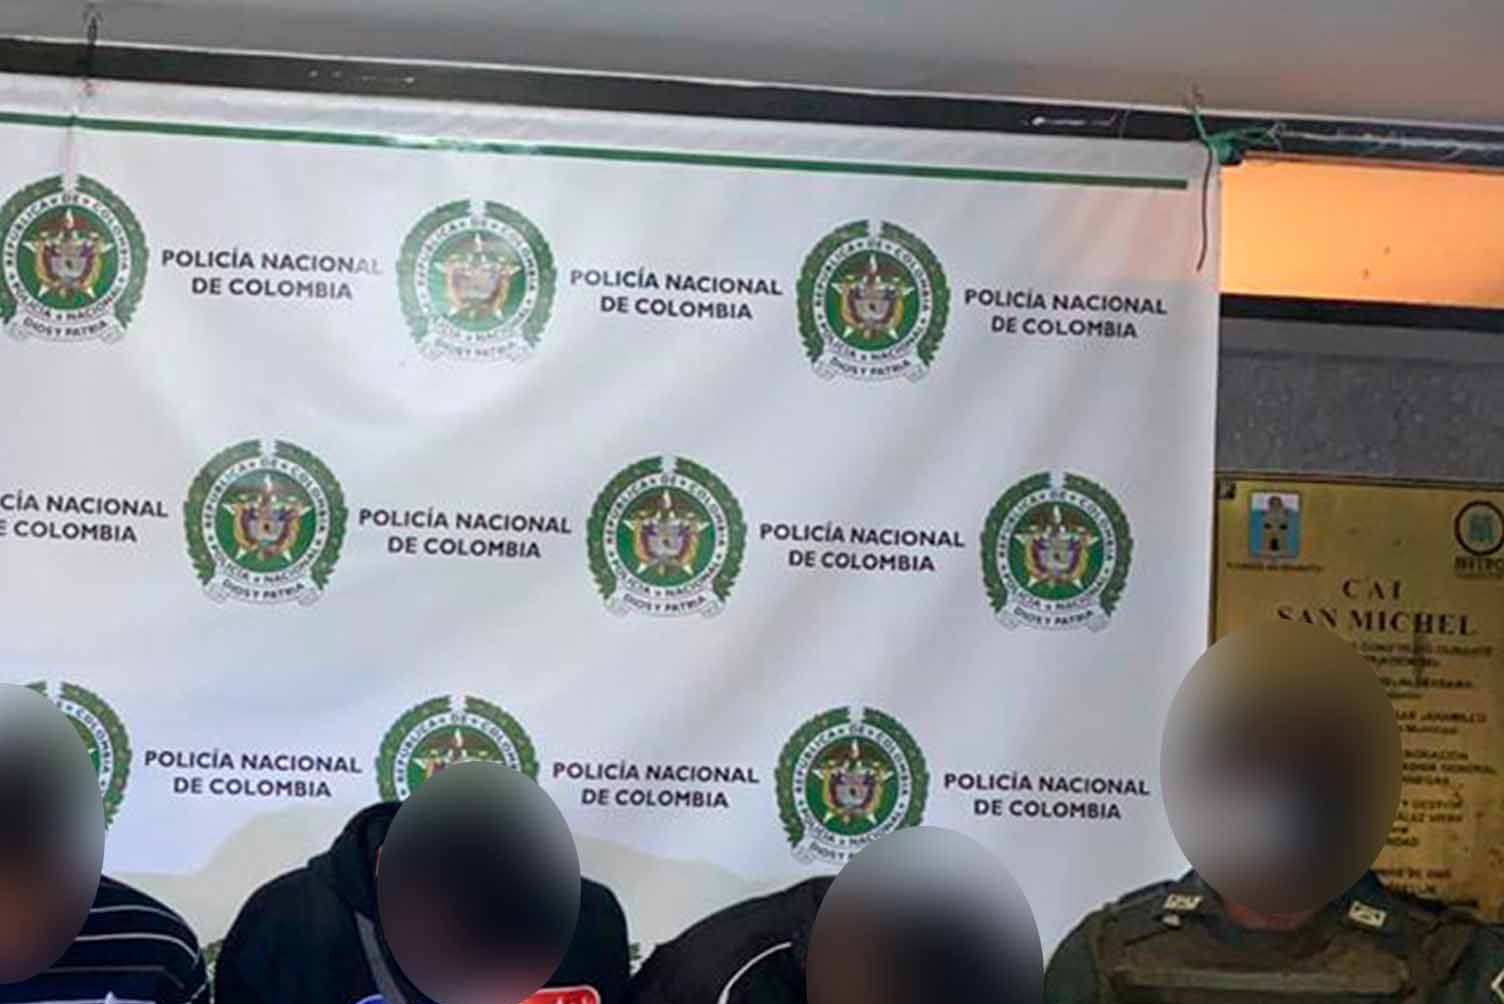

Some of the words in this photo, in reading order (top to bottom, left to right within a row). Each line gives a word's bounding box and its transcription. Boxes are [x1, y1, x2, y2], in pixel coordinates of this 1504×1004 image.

[161, 246, 255, 270] POLICÍA
[261, 252, 379, 274] NACIONAL
[191, 276, 223, 296] DE
[228, 277, 352, 300] COLOMBIA
[571, 267, 660, 290] POLICÍA
[665, 274, 784, 296] NACIONAL
[600, 296, 629, 314] DE
[634, 298, 753, 320] COLOMBIA
[964, 288, 1047, 310] POLICÍA
[1052, 294, 1168, 315] NACIONAL
[990, 315, 1017, 334] DE
[1022, 317, 1139, 339] COLOMBIA
[46, 495, 168, 518] NACIONAL
[13, 520, 137, 543] COLOMBIA
[358, 507, 449, 530] POLICÍA
[456, 512, 572, 534] NACIONAL
[760, 520, 846, 544] POLICÍA
[850, 526, 966, 548] NACIONAL
[387, 535, 418, 554] DE
[423, 537, 541, 558] COLOMBIA
[788, 549, 816, 568] DE
[820, 550, 936, 572] COLOMBIA
[1342, 580, 1401, 599] CAI
[1350, 610, 1477, 635] MICHEL
[144, 748, 235, 770] POLICÍA
[241, 753, 363, 774] NACIONAL
[552, 760, 640, 781] POLICÍA
[645, 765, 760, 784] NACIONAL
[173, 776, 203, 794] DE
[209, 778, 332, 797] COLOMBIA
[944, 770, 1033, 792] POLICÍA
[1038, 776, 1151, 797] NACIONAL
[582, 788, 608, 806] DE
[615, 790, 730, 808] COLOMBIA
[973, 798, 1003, 816] DE
[1008, 799, 1122, 820] COLOMBIA
